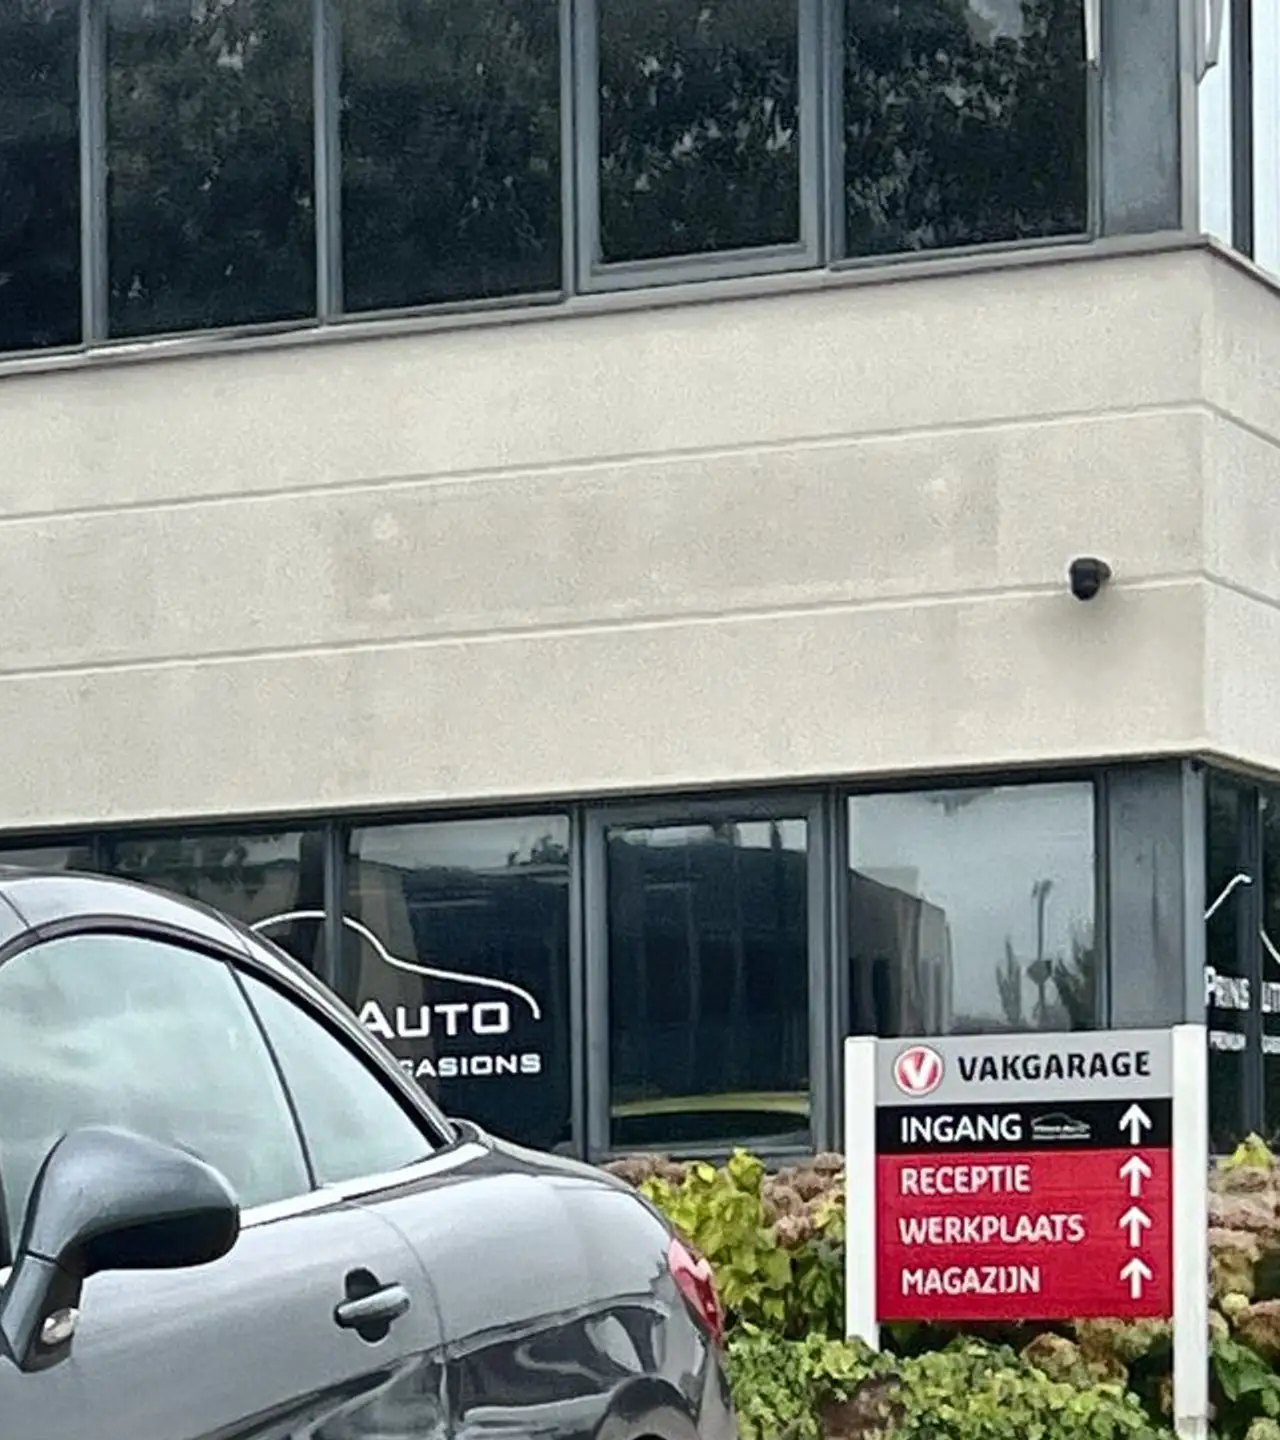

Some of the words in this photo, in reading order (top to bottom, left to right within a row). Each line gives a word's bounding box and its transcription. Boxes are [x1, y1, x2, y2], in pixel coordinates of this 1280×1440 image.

[358, 1000, 509, 1039] AUTO
[957, 1050, 1151, 1082] VAKGARAGE
[900, 1113, 1023, 1143] INGANG
[901, 1163, 1031, 1195] RECEPTIE
[899, 1213, 1086, 1245] WERKPLAATS
[901, 1265, 1040, 1296] MAGAZIJN
